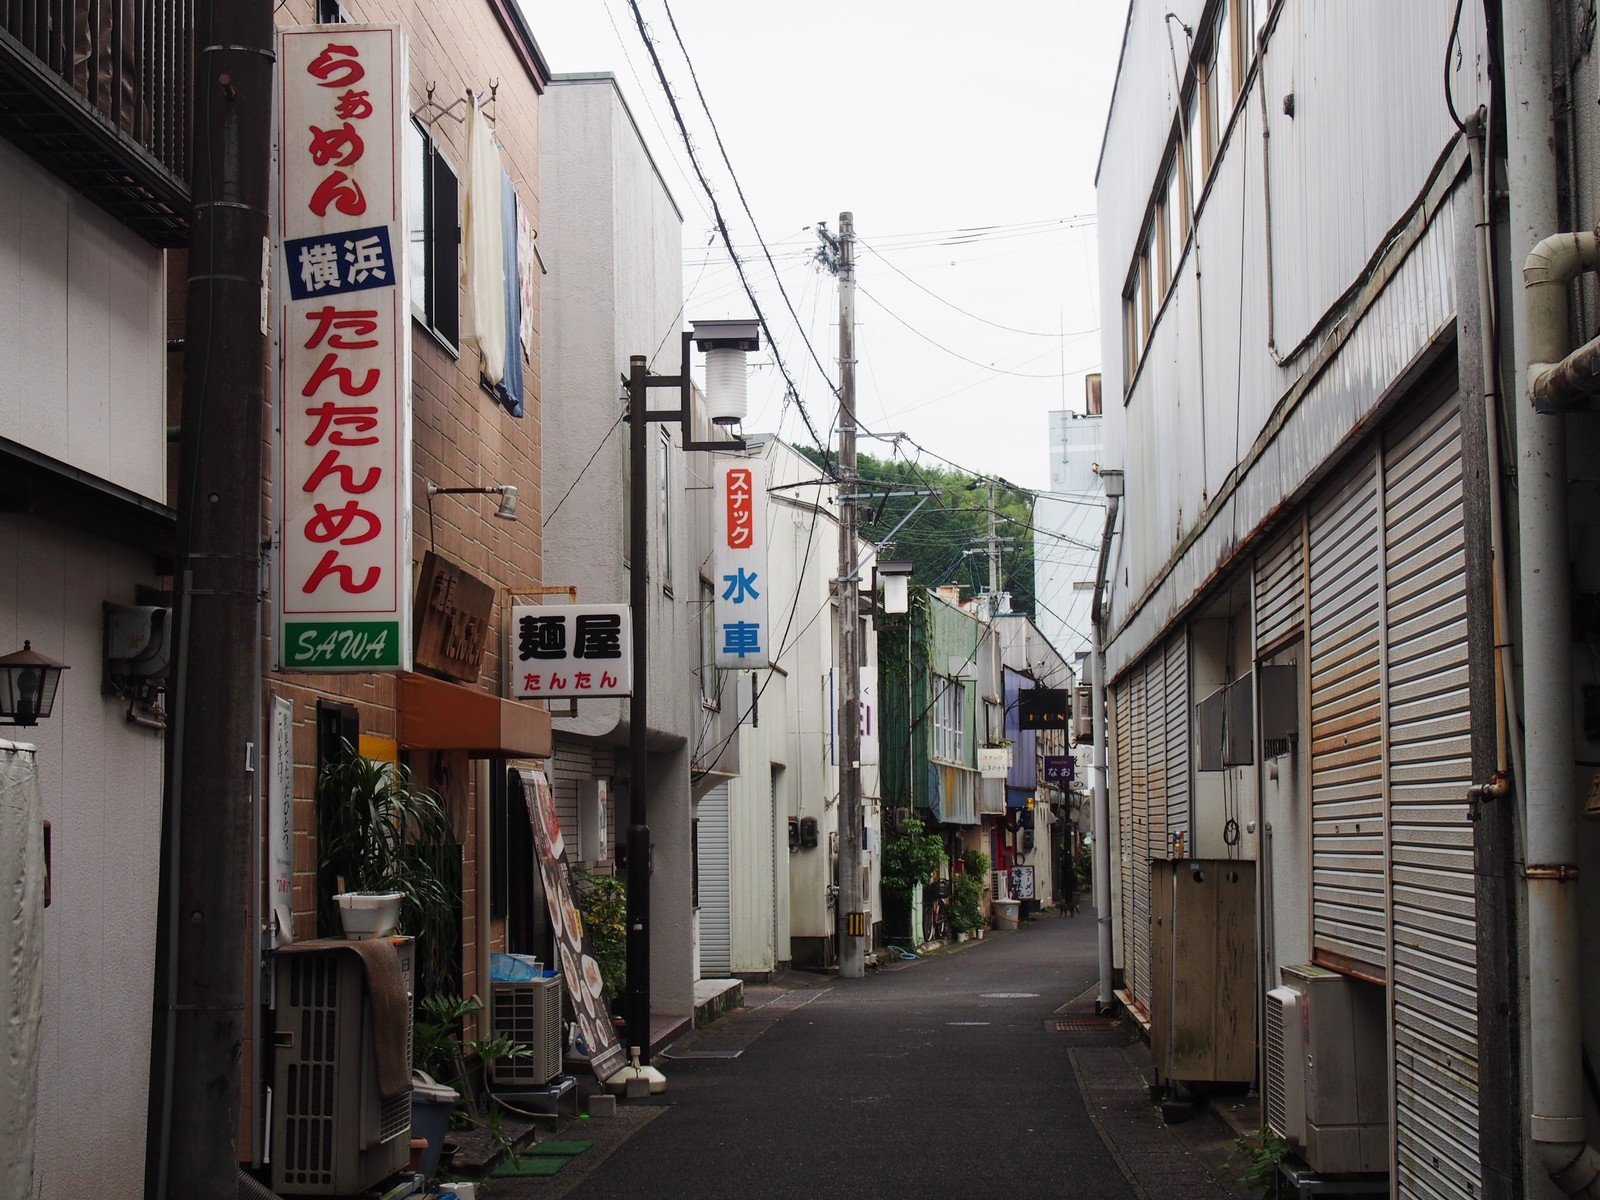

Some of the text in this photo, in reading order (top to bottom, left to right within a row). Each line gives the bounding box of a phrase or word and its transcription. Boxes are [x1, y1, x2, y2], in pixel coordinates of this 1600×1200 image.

[307, 43, 373, 217] らぁめん
[298, 234, 387, 292] 横浜
[302, 305, 381, 595] たんたんめん
[729, 472, 749, 545] スナック
[518, 613, 622, 661] 麺屋
[722, 567, 760, 658] 水車
[295, 628, 389, 662] SAWA
[523, 671, 618, 691] たんたん
[1048, 767, 1071, 778] なお
[1025, 868, 1033, 897] ラーメン
